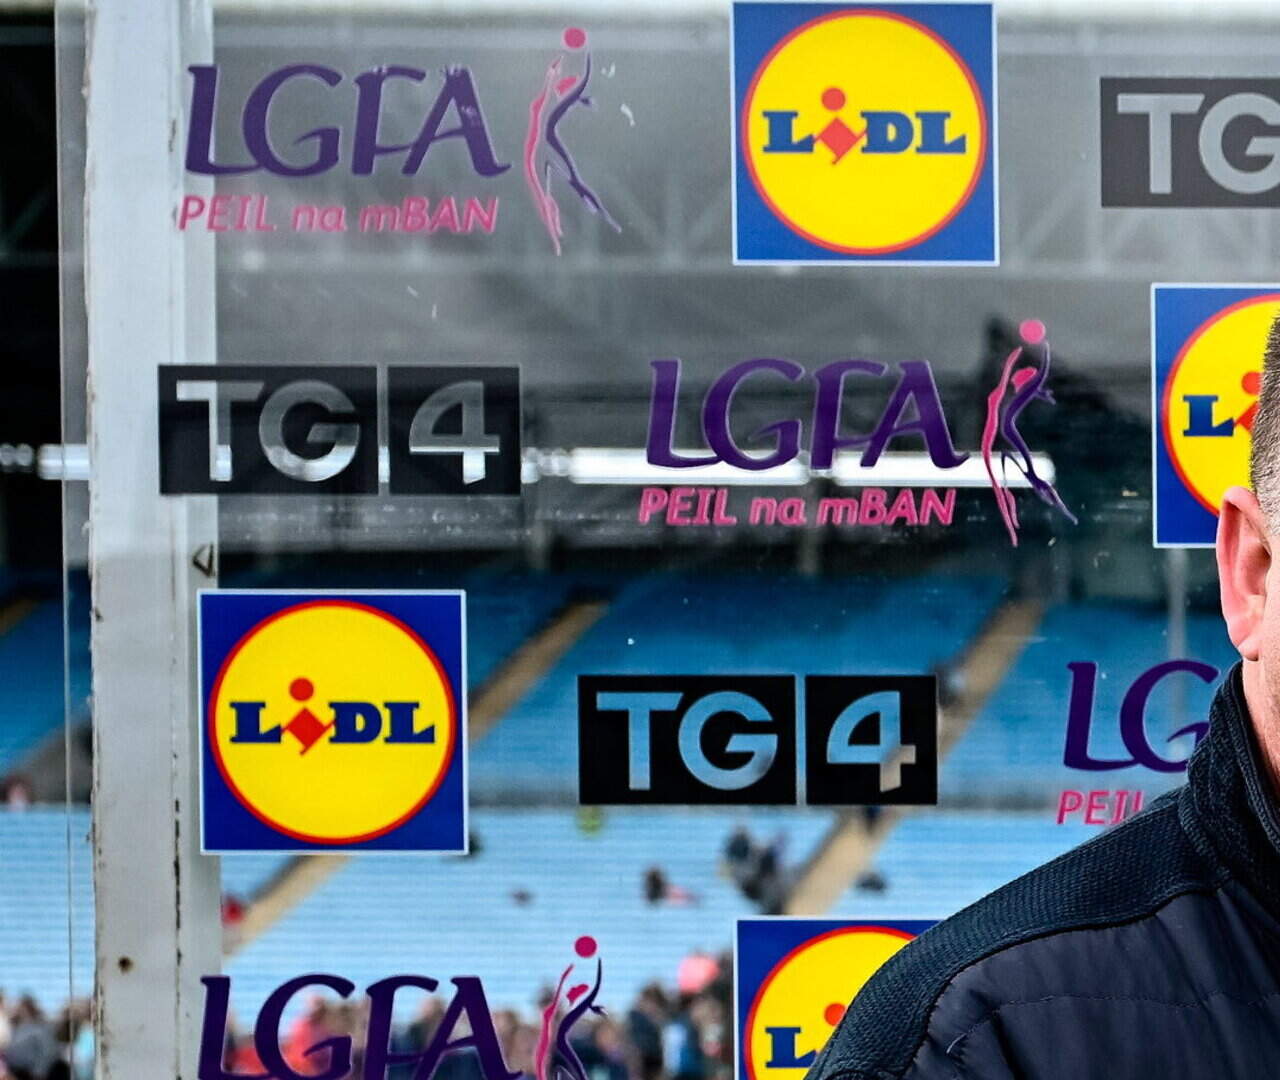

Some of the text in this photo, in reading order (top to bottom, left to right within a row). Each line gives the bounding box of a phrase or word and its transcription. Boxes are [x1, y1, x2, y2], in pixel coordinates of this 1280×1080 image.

[184, 64, 512, 178] LGFA
[178, 197, 498, 233] PEIL na mBAN
[644, 358, 971, 471] LGFA
[639, 489, 956, 526] PEIL na mBAN
[1064, 660, 1219, 774] LG
